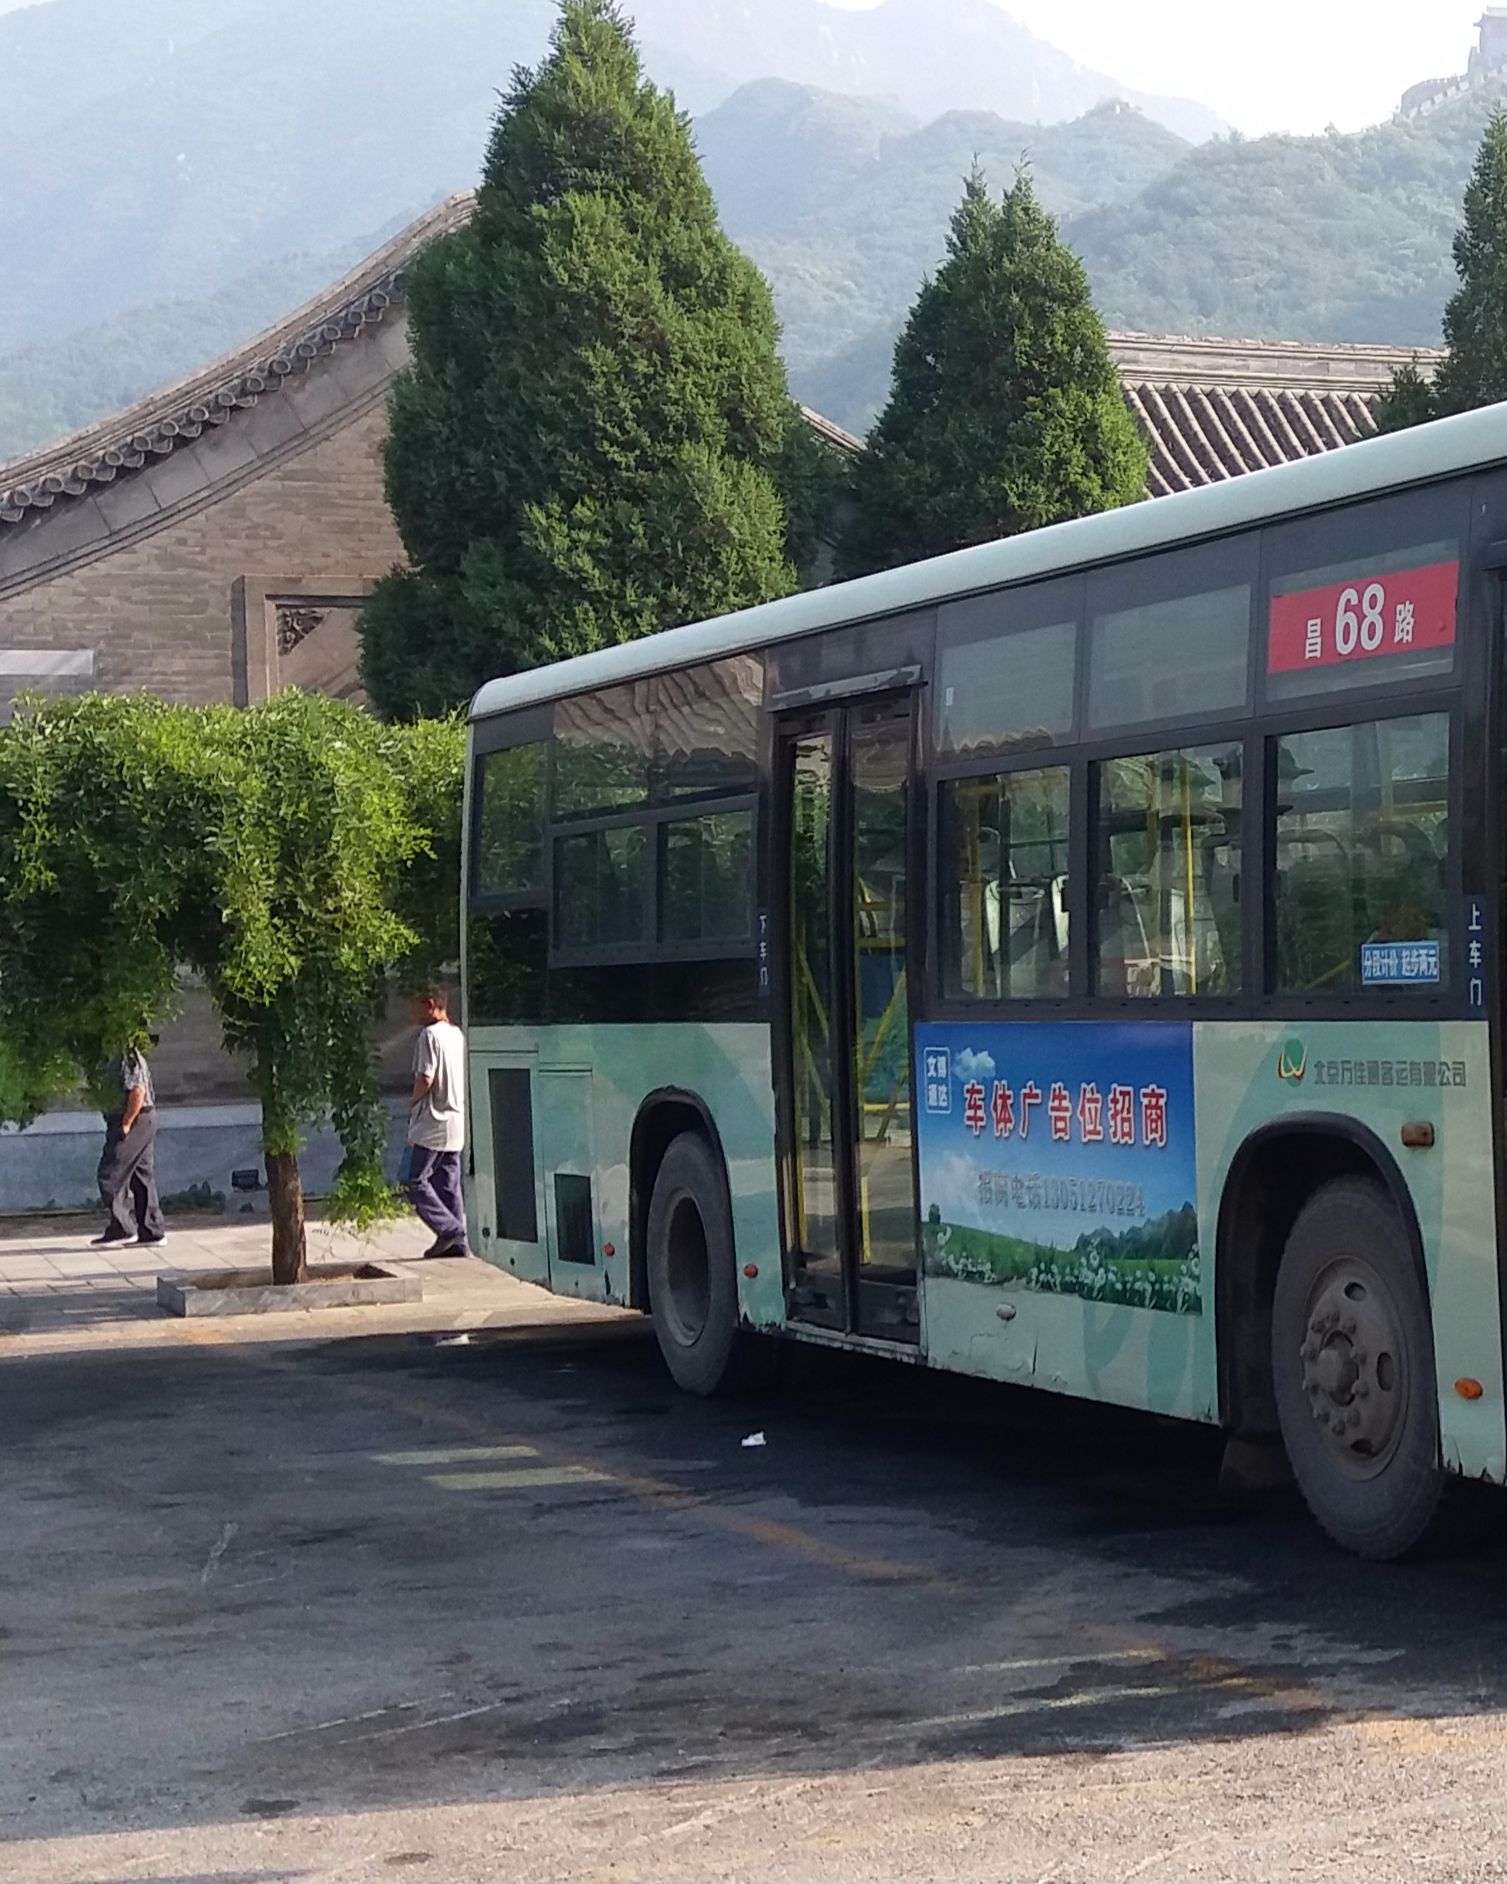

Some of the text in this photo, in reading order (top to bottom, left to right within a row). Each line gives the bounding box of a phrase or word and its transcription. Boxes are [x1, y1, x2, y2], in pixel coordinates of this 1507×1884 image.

[1467, 903, 1482, 1006] 上车门
[963, 1079, 1167, 1148] 车体广告位招商
